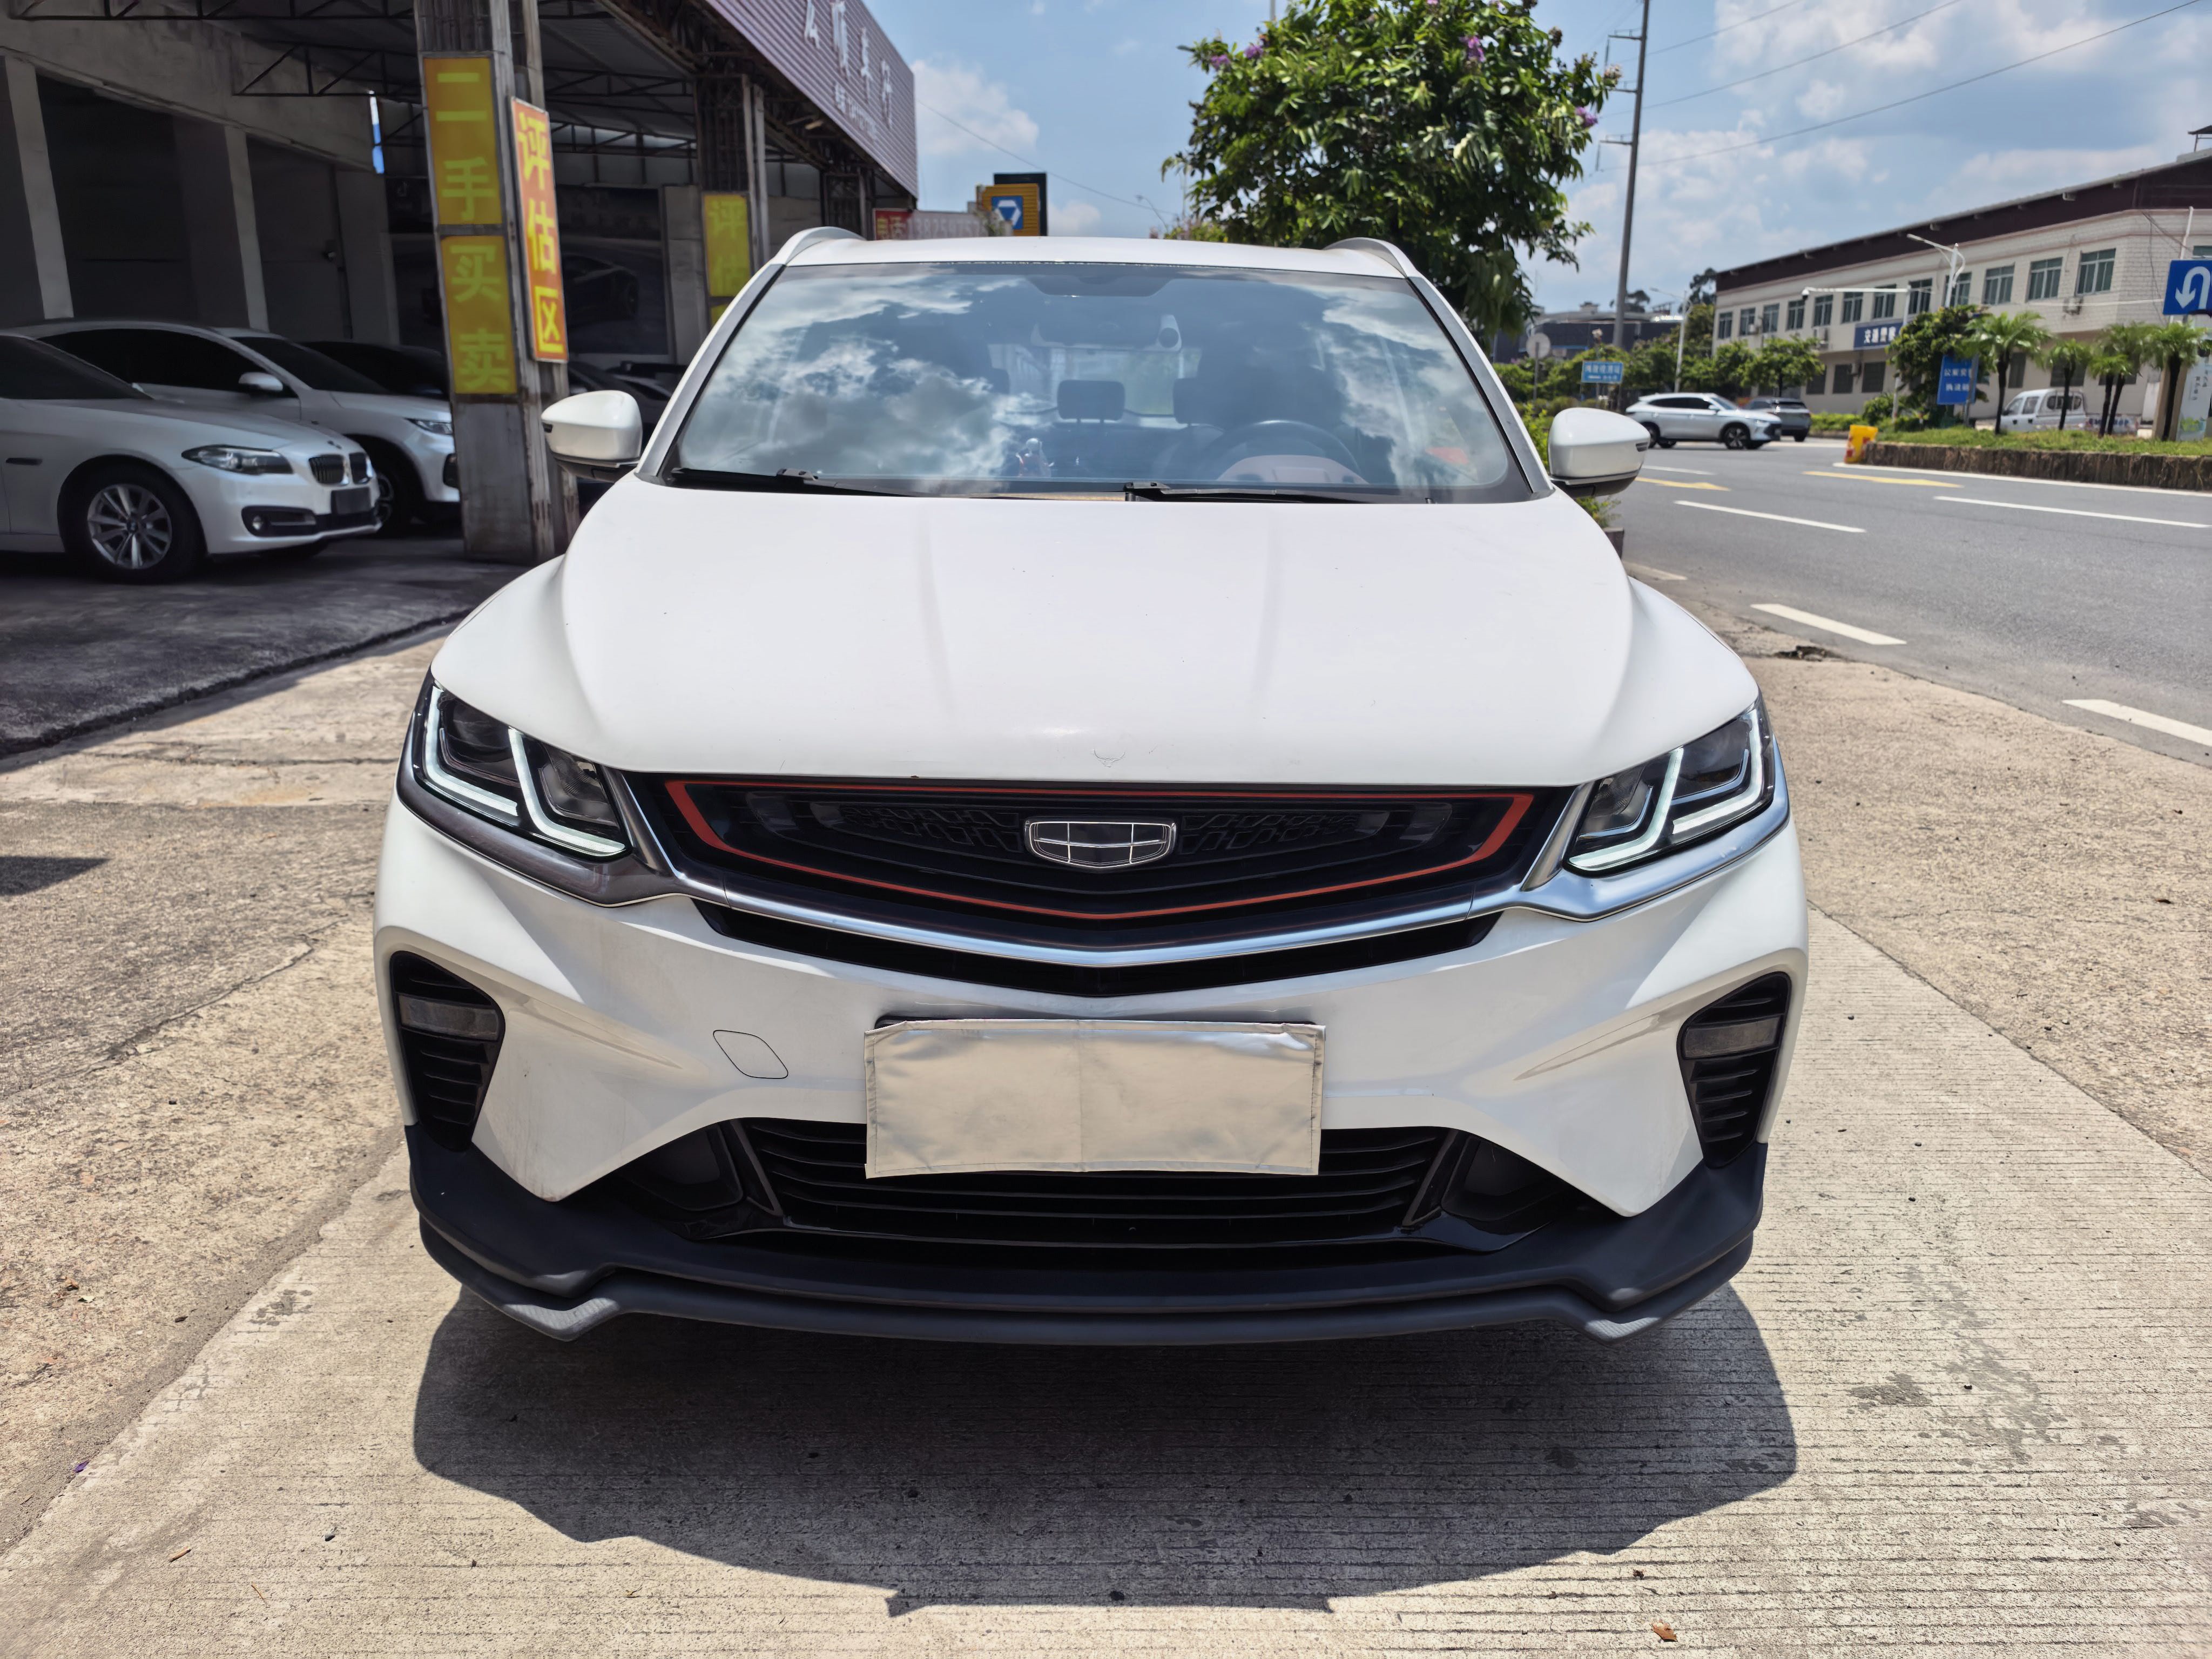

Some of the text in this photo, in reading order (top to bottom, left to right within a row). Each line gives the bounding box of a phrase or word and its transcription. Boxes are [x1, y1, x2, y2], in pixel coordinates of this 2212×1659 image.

[436, 72, 510, 390] 二手买卖
[512, 111, 563, 353] 评估区
